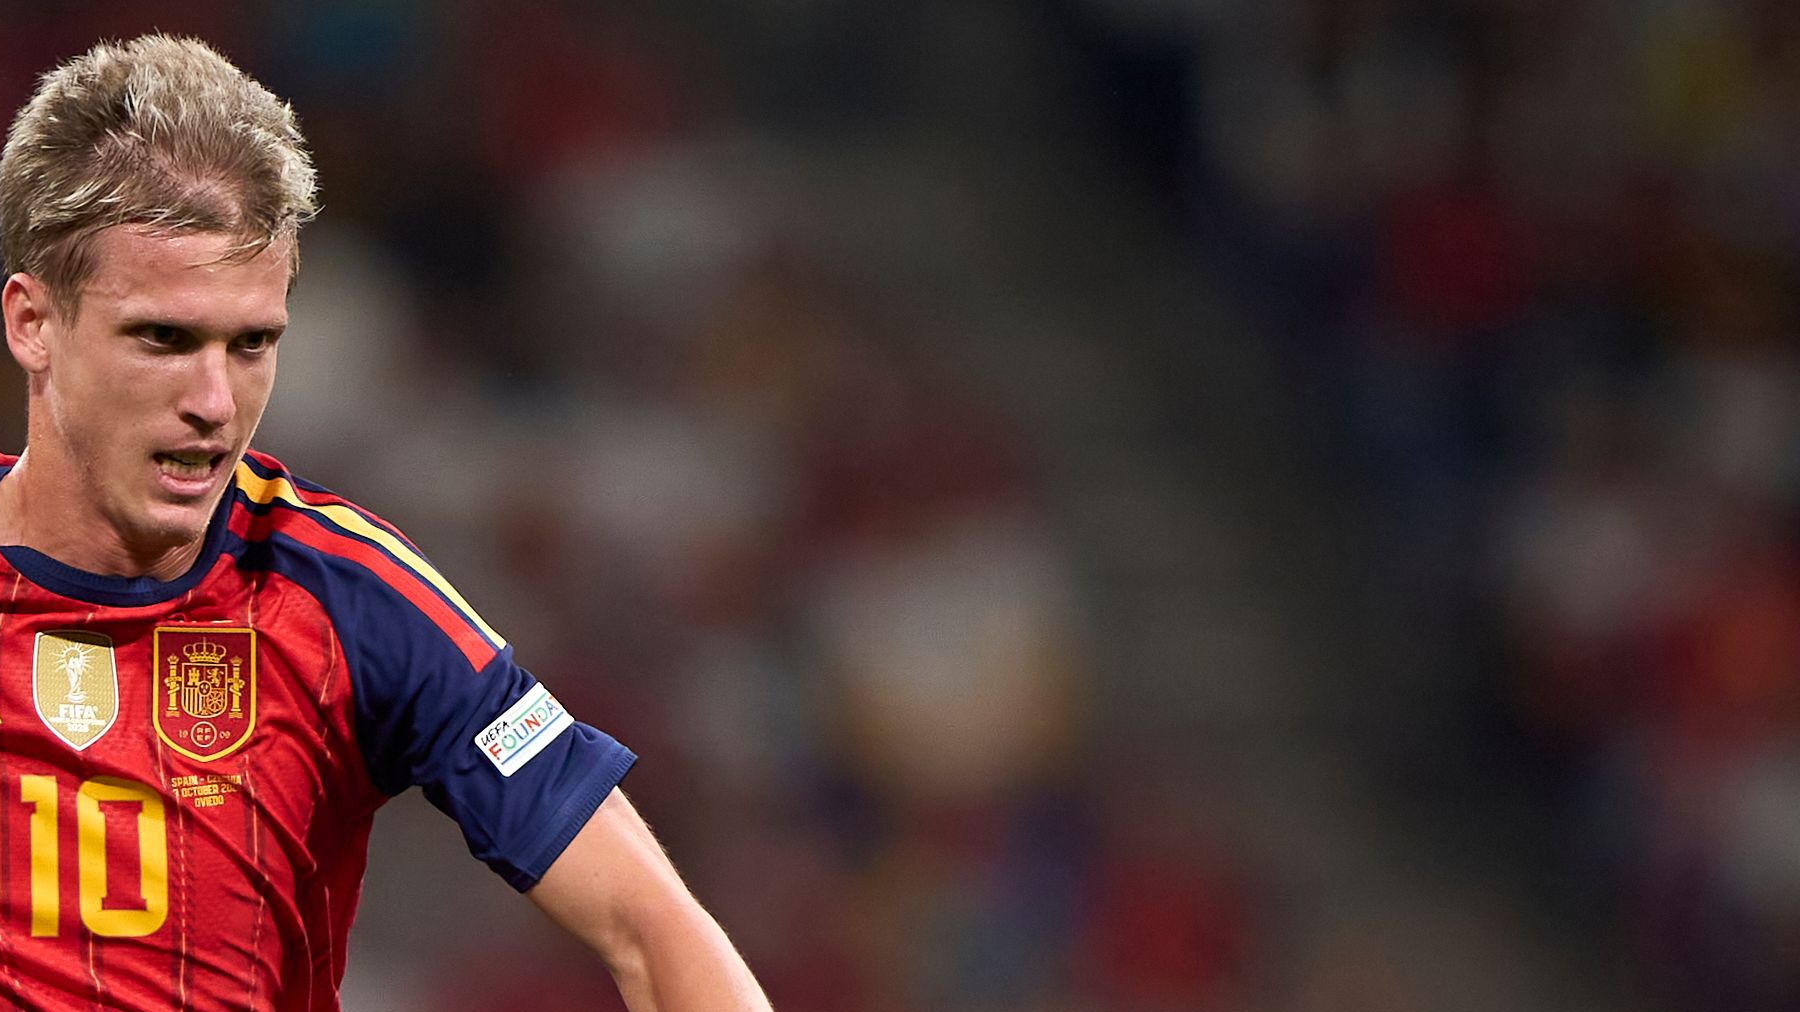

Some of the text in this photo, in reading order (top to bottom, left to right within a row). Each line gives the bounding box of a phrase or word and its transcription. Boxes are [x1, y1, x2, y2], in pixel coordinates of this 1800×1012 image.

[59, 703, 96, 719] FIFA
[481, 721, 510, 746] UEFA
[171, 775, 199, 788] SPAIN
[181, 784, 219, 798] OCTOBER
[194, 795, 225, 808] OVIEDO
[20, 775, 168, 938] 10
